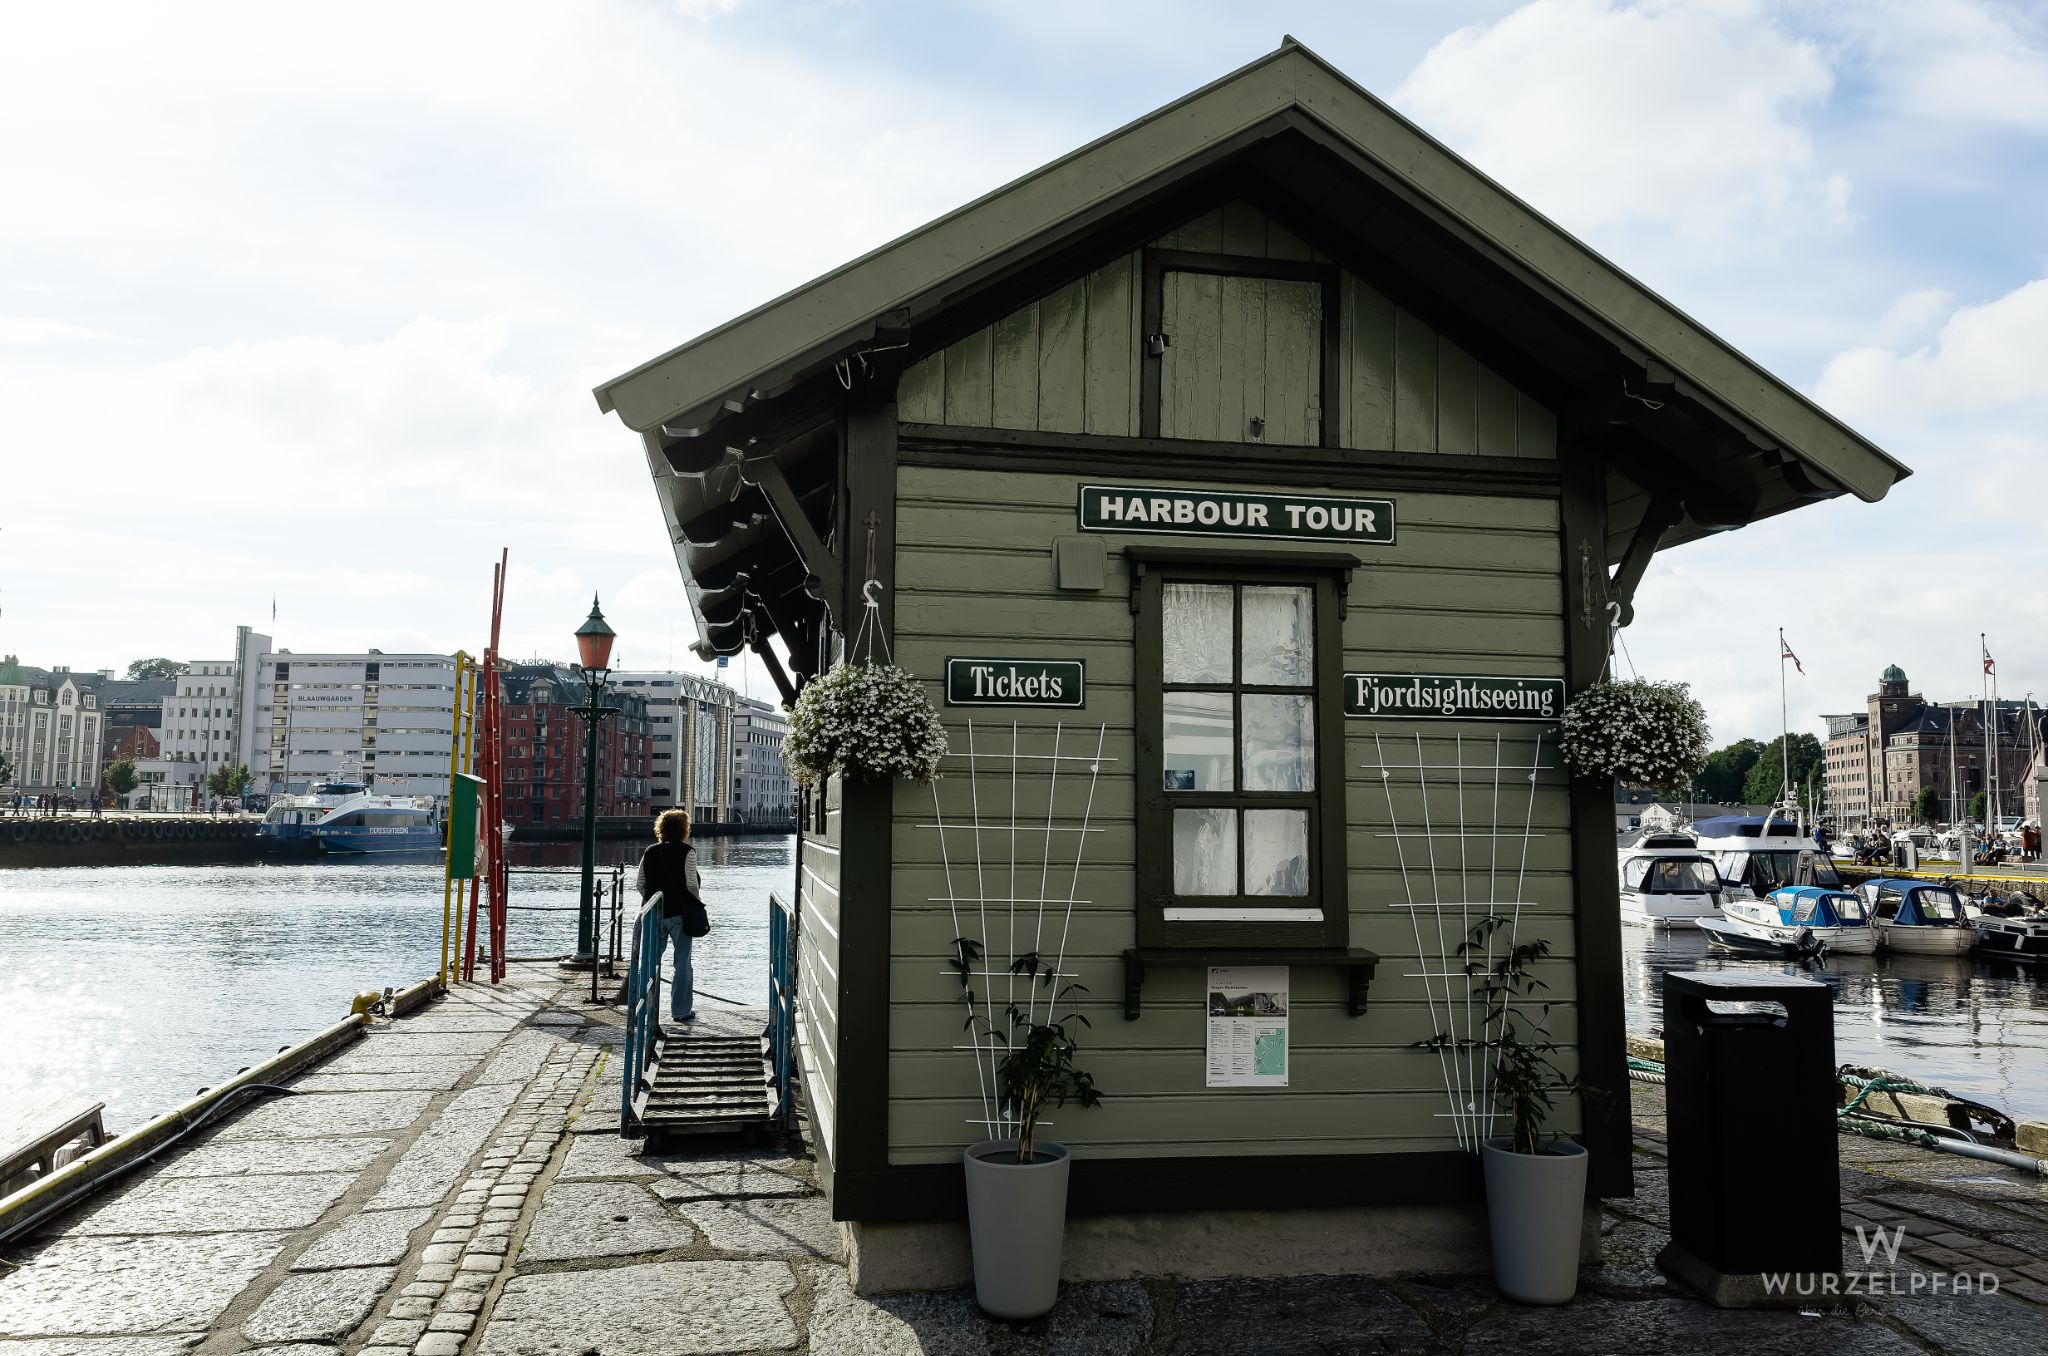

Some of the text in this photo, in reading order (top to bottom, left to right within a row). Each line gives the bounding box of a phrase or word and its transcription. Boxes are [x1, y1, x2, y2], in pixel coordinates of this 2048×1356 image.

[1100, 496, 1377, 533] HARBOUR TOUR
[970, 666, 1063, 699] Tickets
[1355, 677, 1554, 716] Fjordsightseeing
